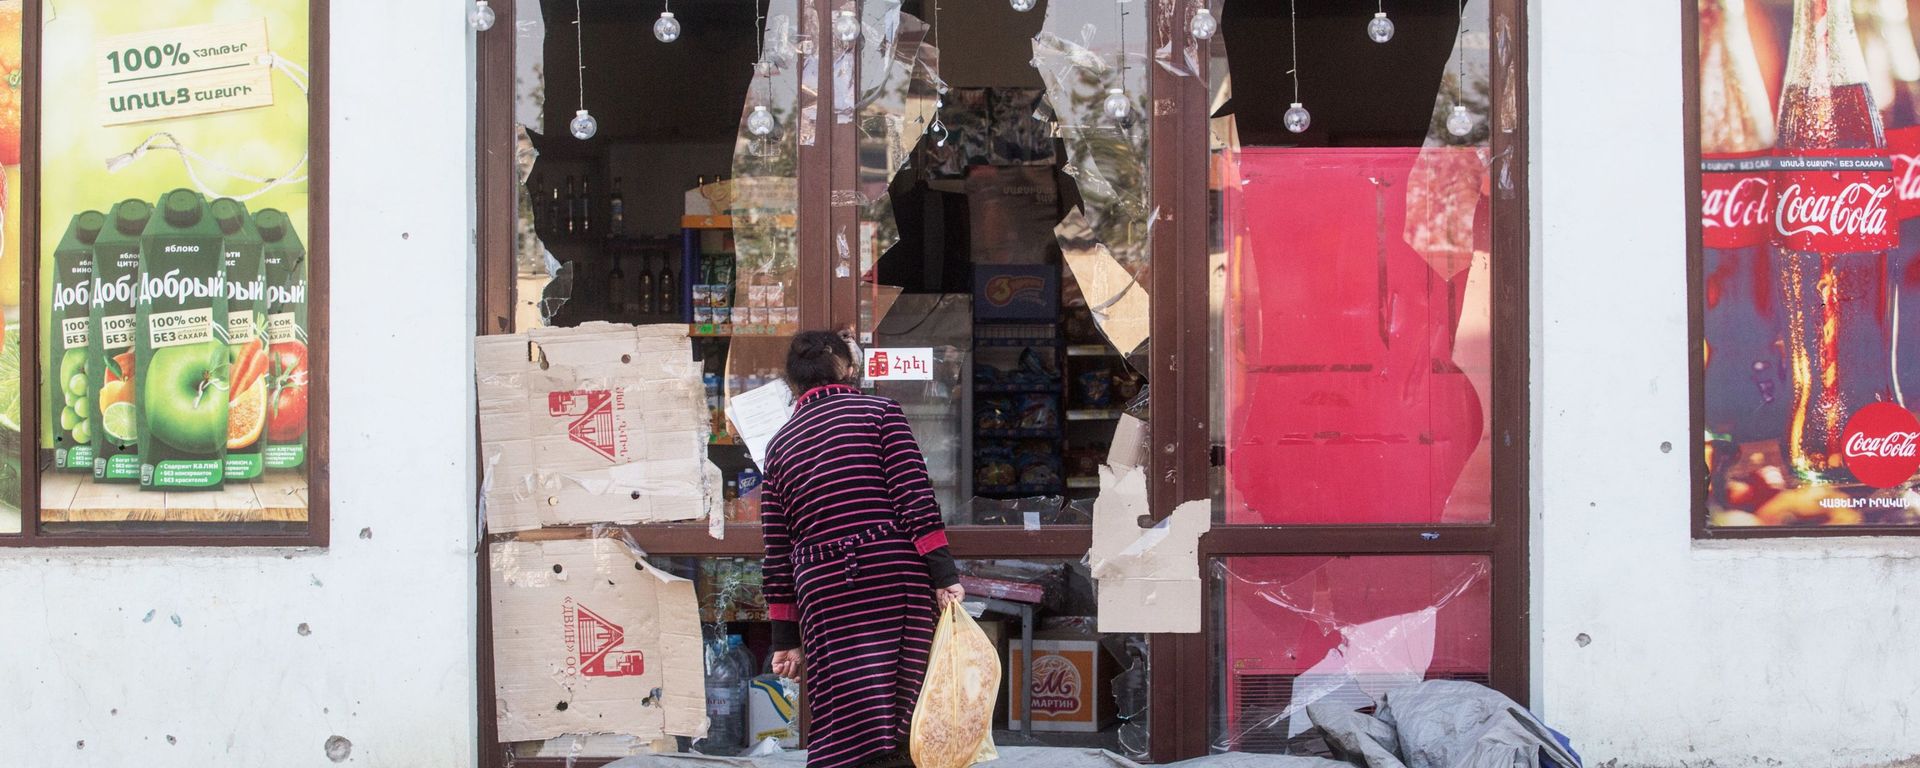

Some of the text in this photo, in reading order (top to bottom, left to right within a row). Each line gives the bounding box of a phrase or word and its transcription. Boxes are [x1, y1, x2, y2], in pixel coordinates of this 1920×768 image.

[107, 42, 190, 74] 100%
[109, 85, 252, 113] ԱՌԱՆՑ ՇԱՔԱՐԻ
[1755, 160, 1772, 168] САХ
[1839, 160, 1885, 168] БЕЗ САХАРА
[1776, 183, 1894, 236] Coca-Cola
[165, 245, 200, 253] яблоко
[139, 268, 226, 305] Добрый
[54, 279, 91, 312] Доб
[152, 315, 186, 329] 100%
[66, 334, 86, 345] БЕЗ
[106, 333, 128, 344] БЕЗ
[153, 331, 208, 343] БЕЗ САХАРА
[894, 355, 928, 374] Հրել
[1846, 431, 1920, 457] Coca-Cola
[566, 656, 577, 678] ОО
[1031, 699, 1074, 709] МАРТИН
